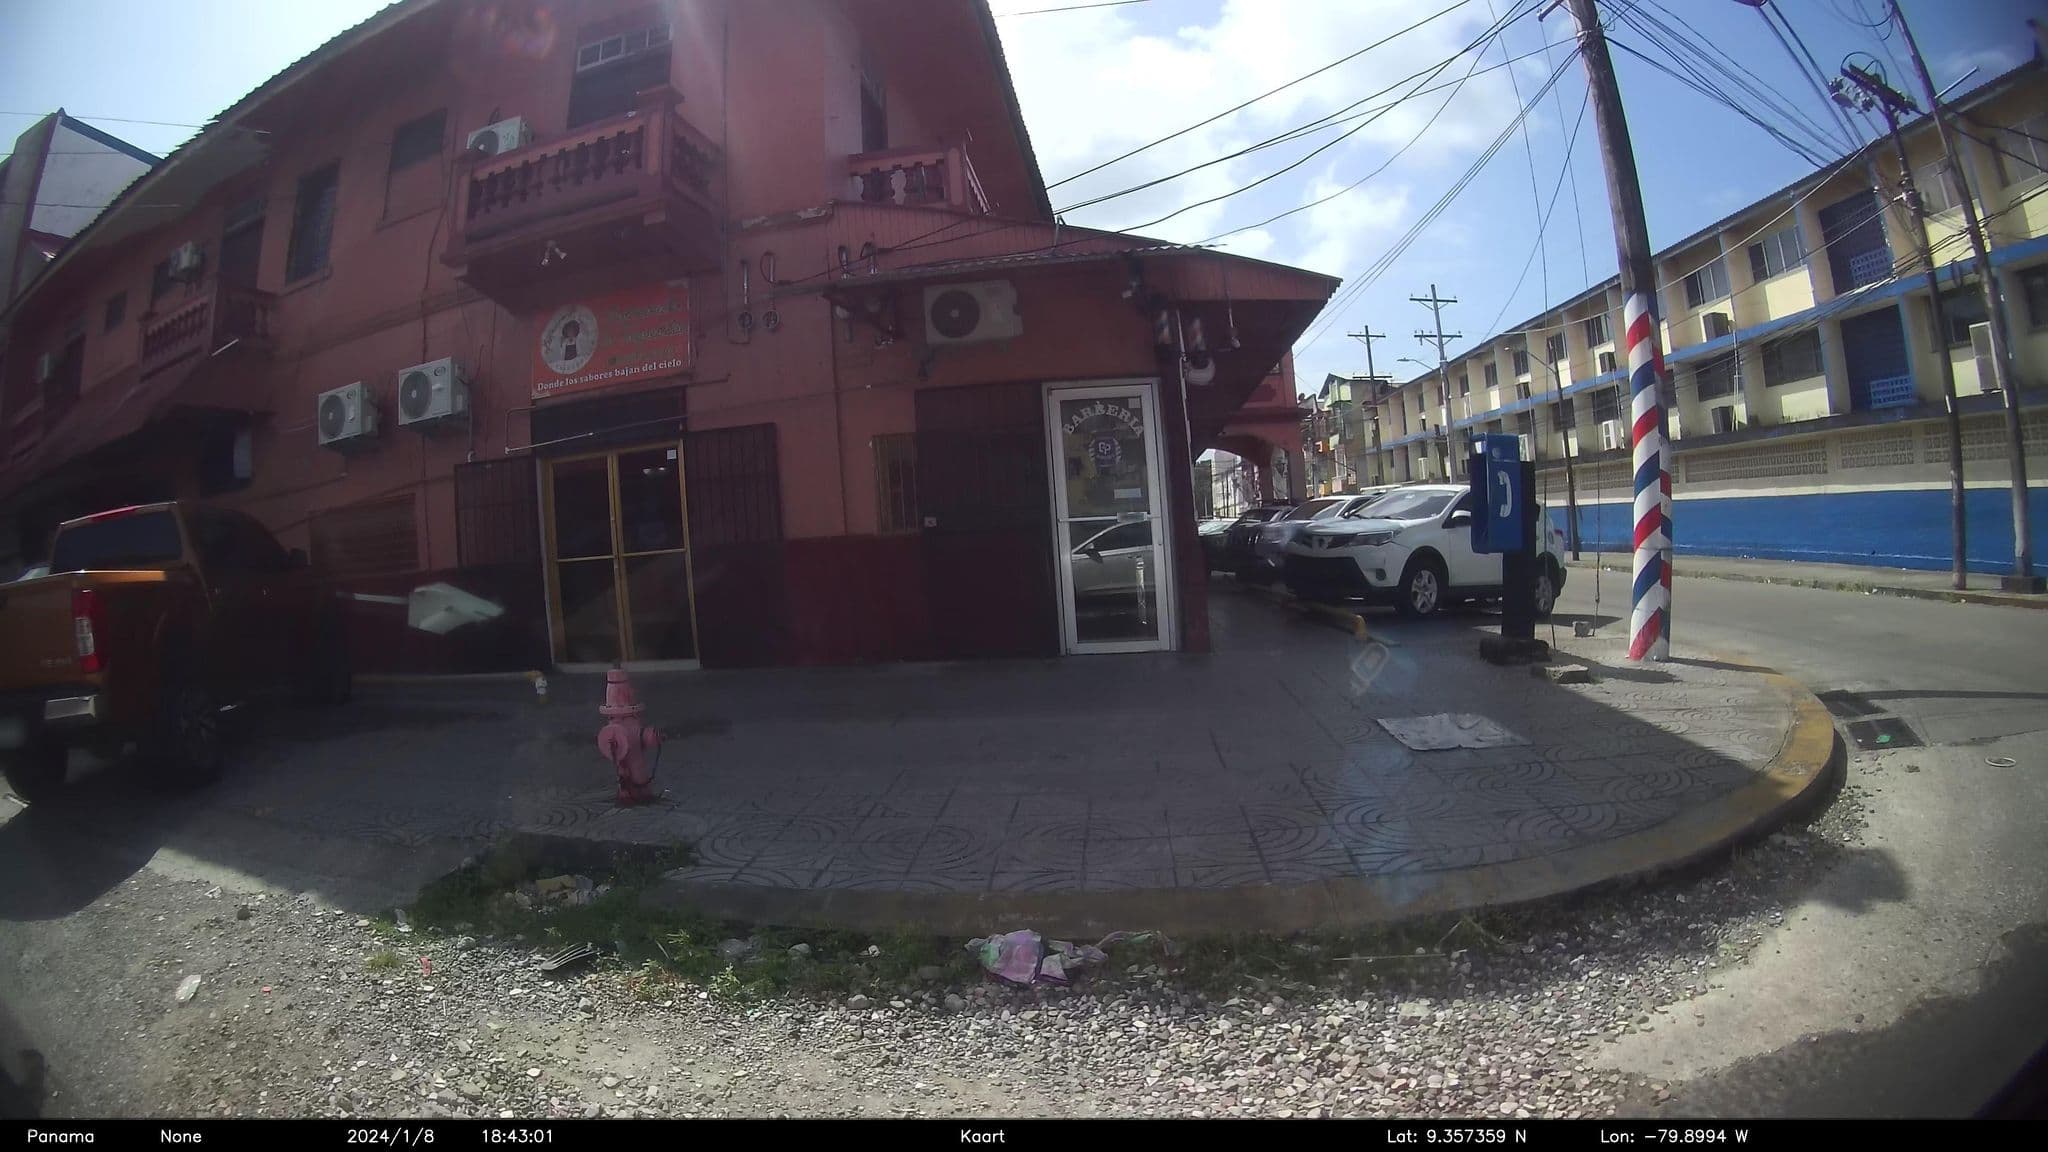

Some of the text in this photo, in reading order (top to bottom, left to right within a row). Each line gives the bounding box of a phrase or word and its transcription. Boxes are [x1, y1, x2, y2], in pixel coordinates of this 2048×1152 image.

[537, 358, 682, 391] Donde los sabores bajan del cielo
[1063, 403, 1144, 438] BARBERIA
